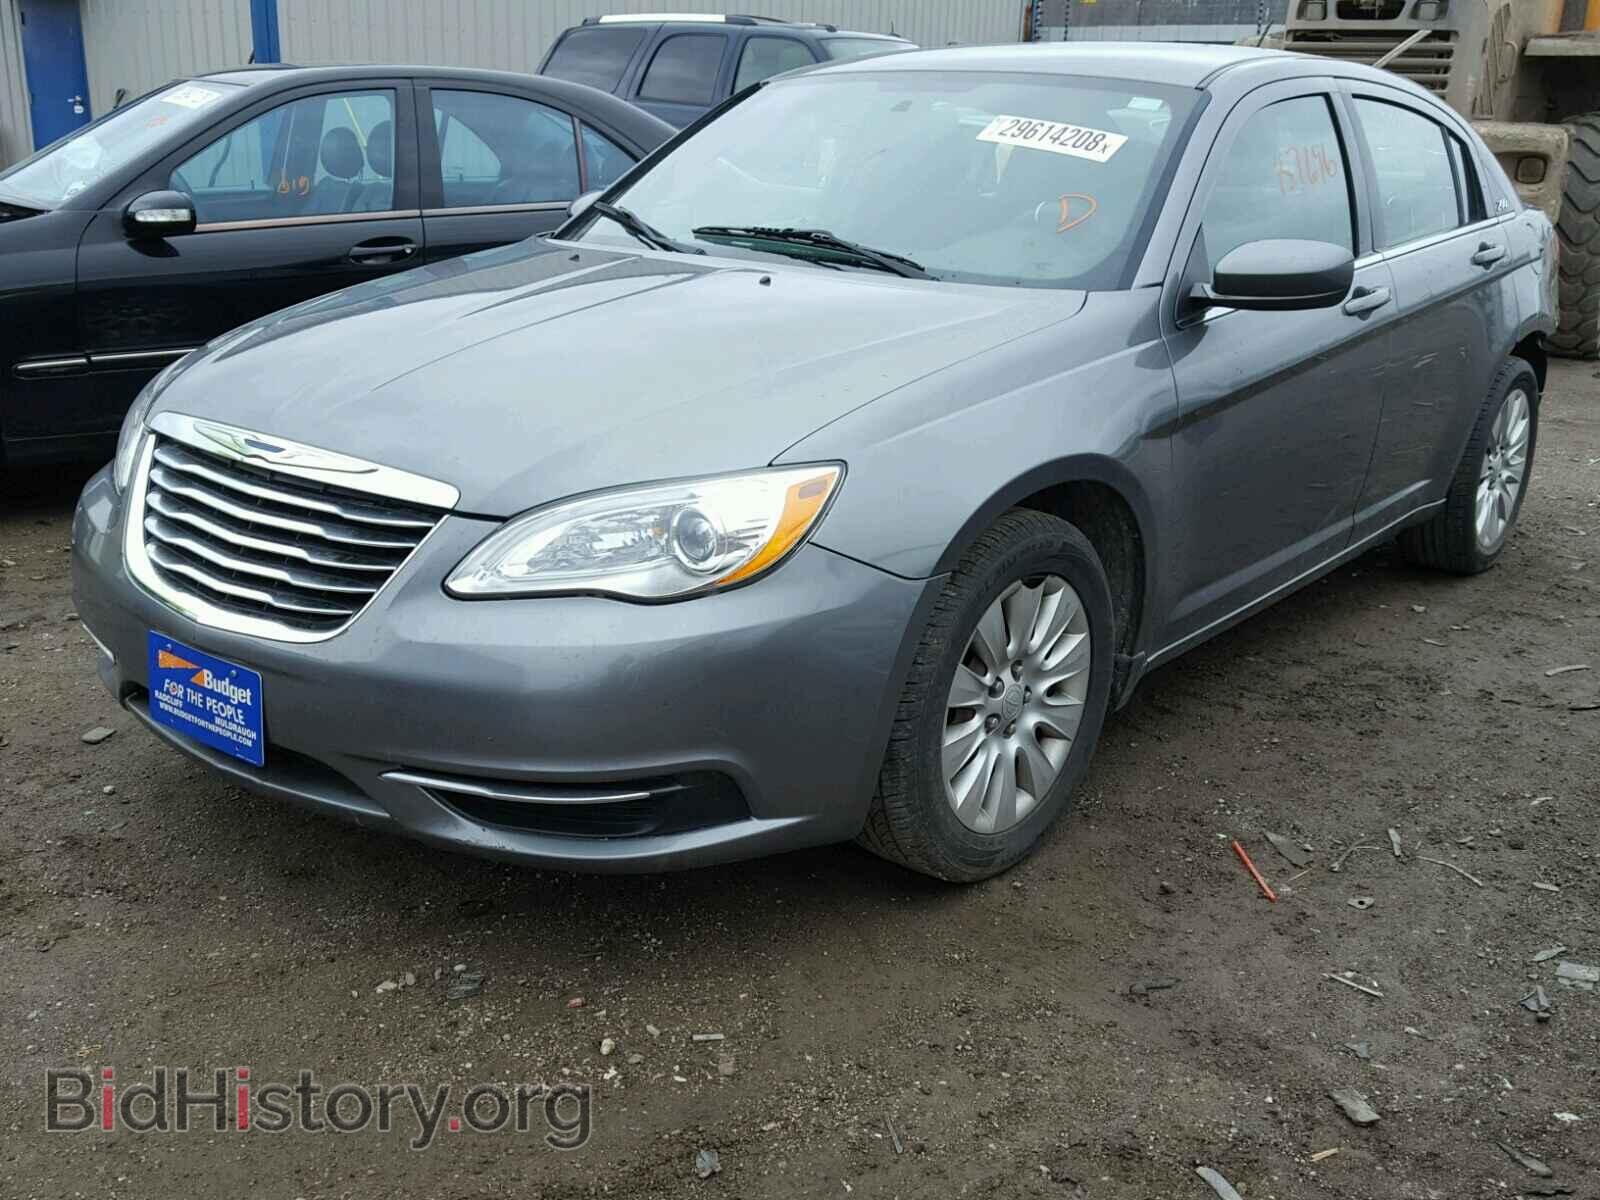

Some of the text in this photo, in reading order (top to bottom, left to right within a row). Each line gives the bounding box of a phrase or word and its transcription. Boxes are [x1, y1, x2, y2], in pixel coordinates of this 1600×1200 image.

[1056, 192, 1098, 233] D
[163, 678, 245, 725] FOR THE PEOPLE
[203, 668, 252, 706] Budget
